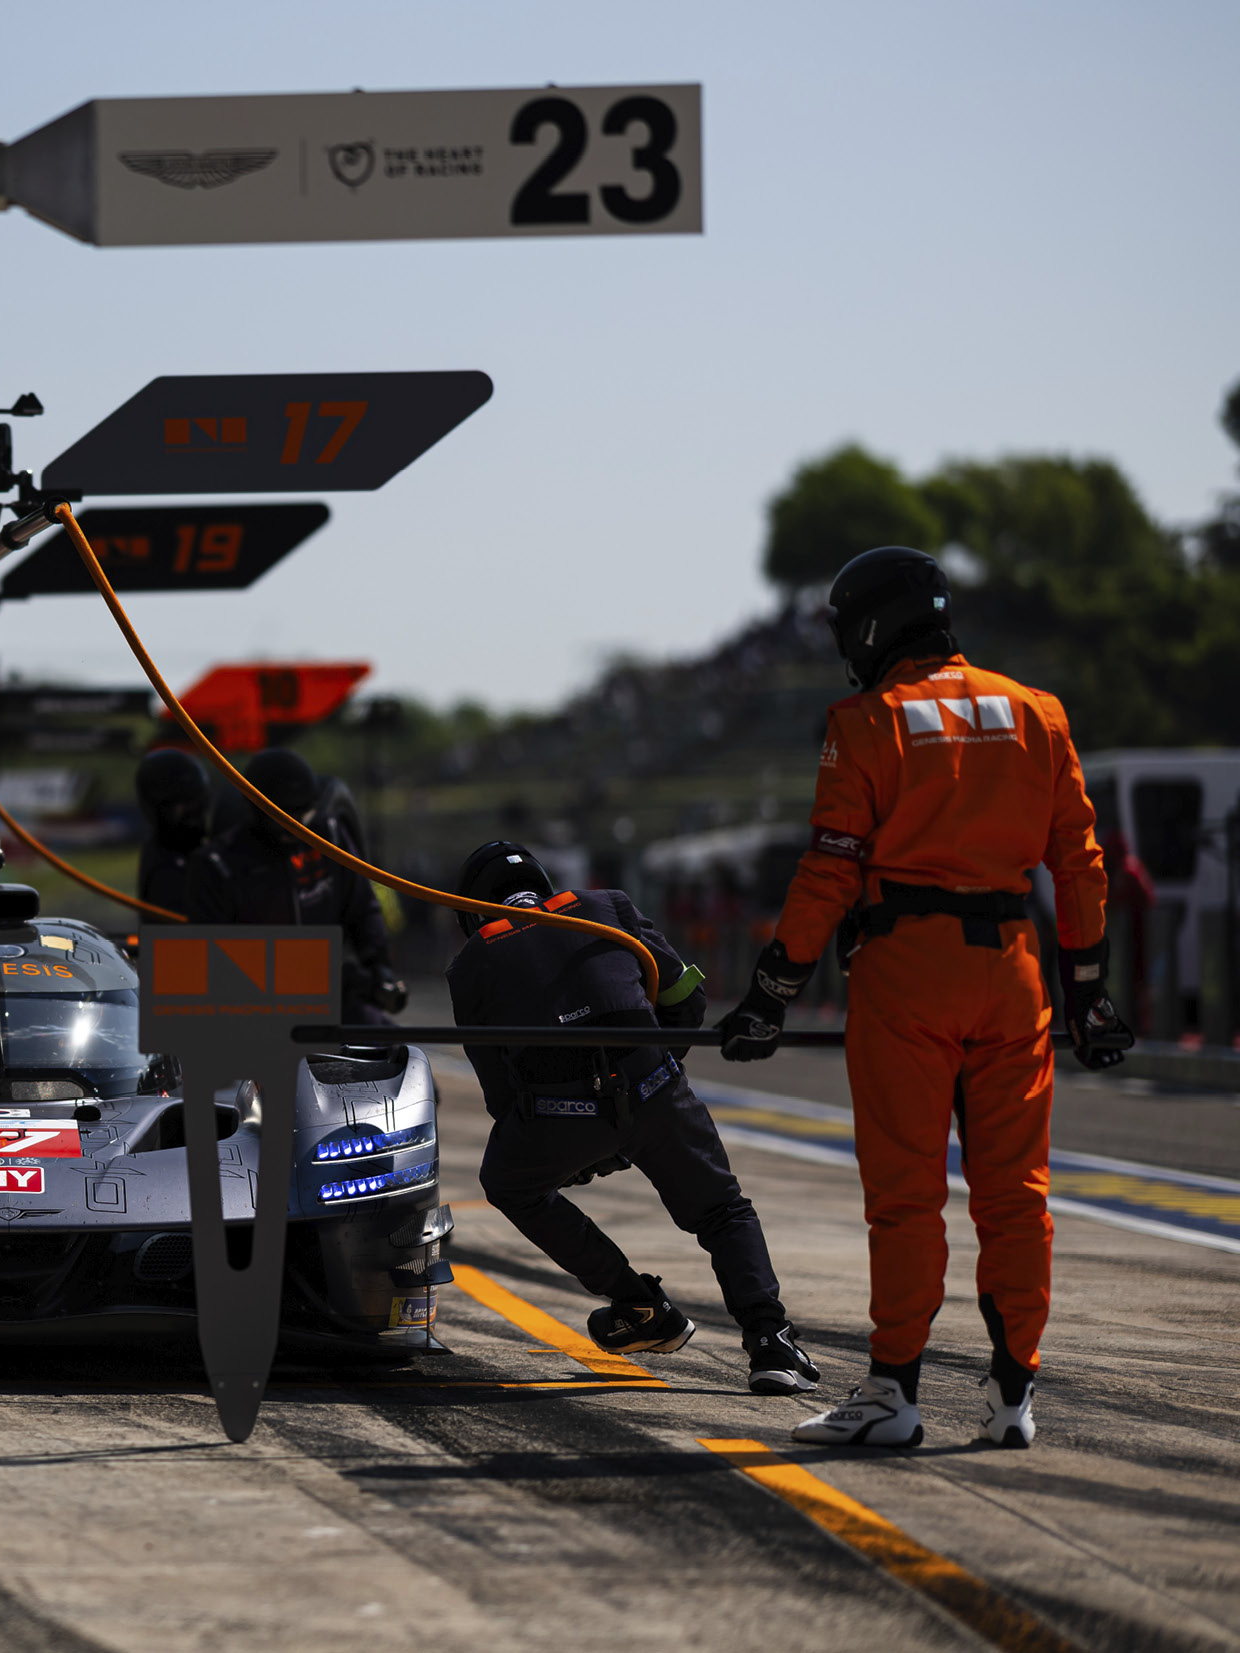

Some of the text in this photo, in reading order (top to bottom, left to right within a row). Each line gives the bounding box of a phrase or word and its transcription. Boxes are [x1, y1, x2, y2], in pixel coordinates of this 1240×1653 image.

[384, 146, 483, 161] THE HEART
[510, 95, 682, 226] 23
[384, 164, 483, 177] OF RACING
[280, 401, 368, 464] 17
[172, 524, 244, 573] 19
[911, 735, 952, 747] GENESIS
[982, 733, 1018, 743] RACING
[152, 1004, 330, 1016] GENESIS MAGMA RACING
[558, 1005, 591, 1023] sparco
[536, 1099, 597, 1115] sparco
